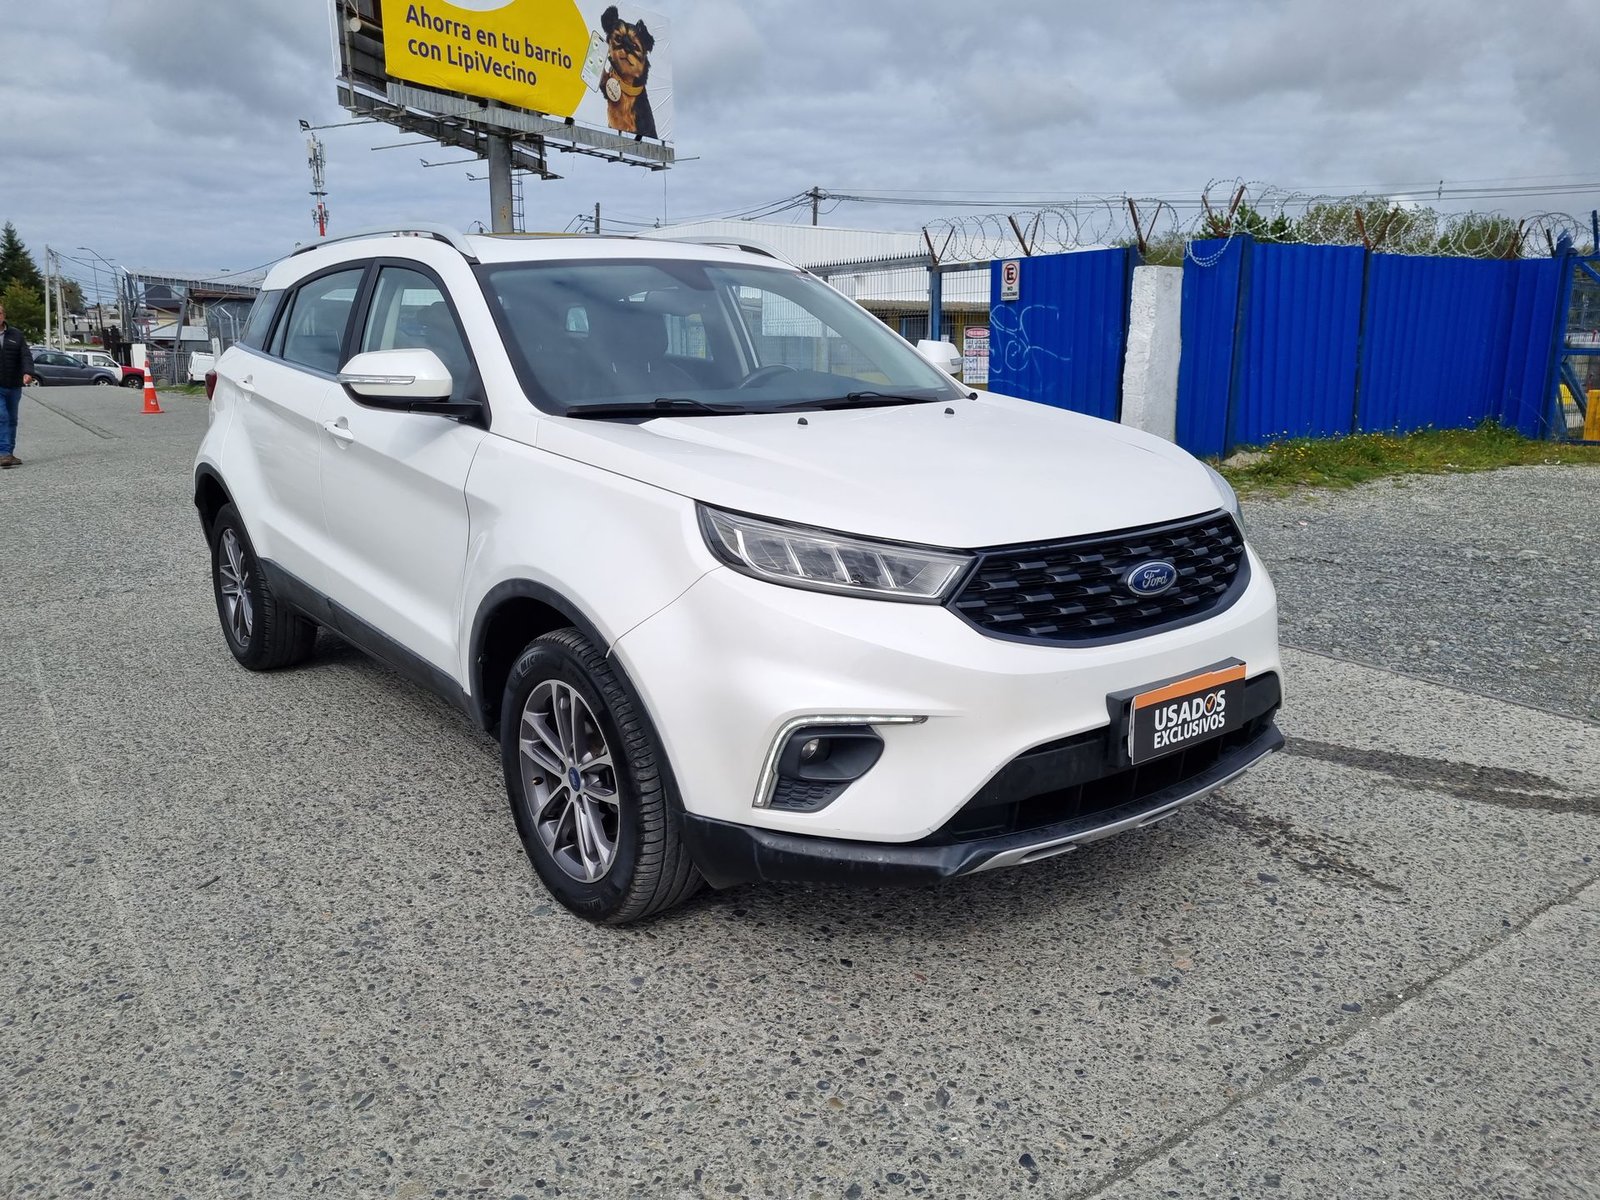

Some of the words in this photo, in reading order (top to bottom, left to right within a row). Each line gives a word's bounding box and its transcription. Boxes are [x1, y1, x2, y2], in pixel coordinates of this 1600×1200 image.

[406, 4, 471, 41] Ahorra
[476, 29, 497, 48] en
[502, 33, 520, 54] tu
[525, 37, 572, 69] barrio
[408, 38, 441, 61] con
[447, 44, 537, 86] LipiVecino
[1006, 267, 1014, 281] E
[1142, 568, 1168, 589] Ford
[1154, 689, 1226, 730] USADOS
[1153, 711, 1226, 749] EXCLUSIVOS
